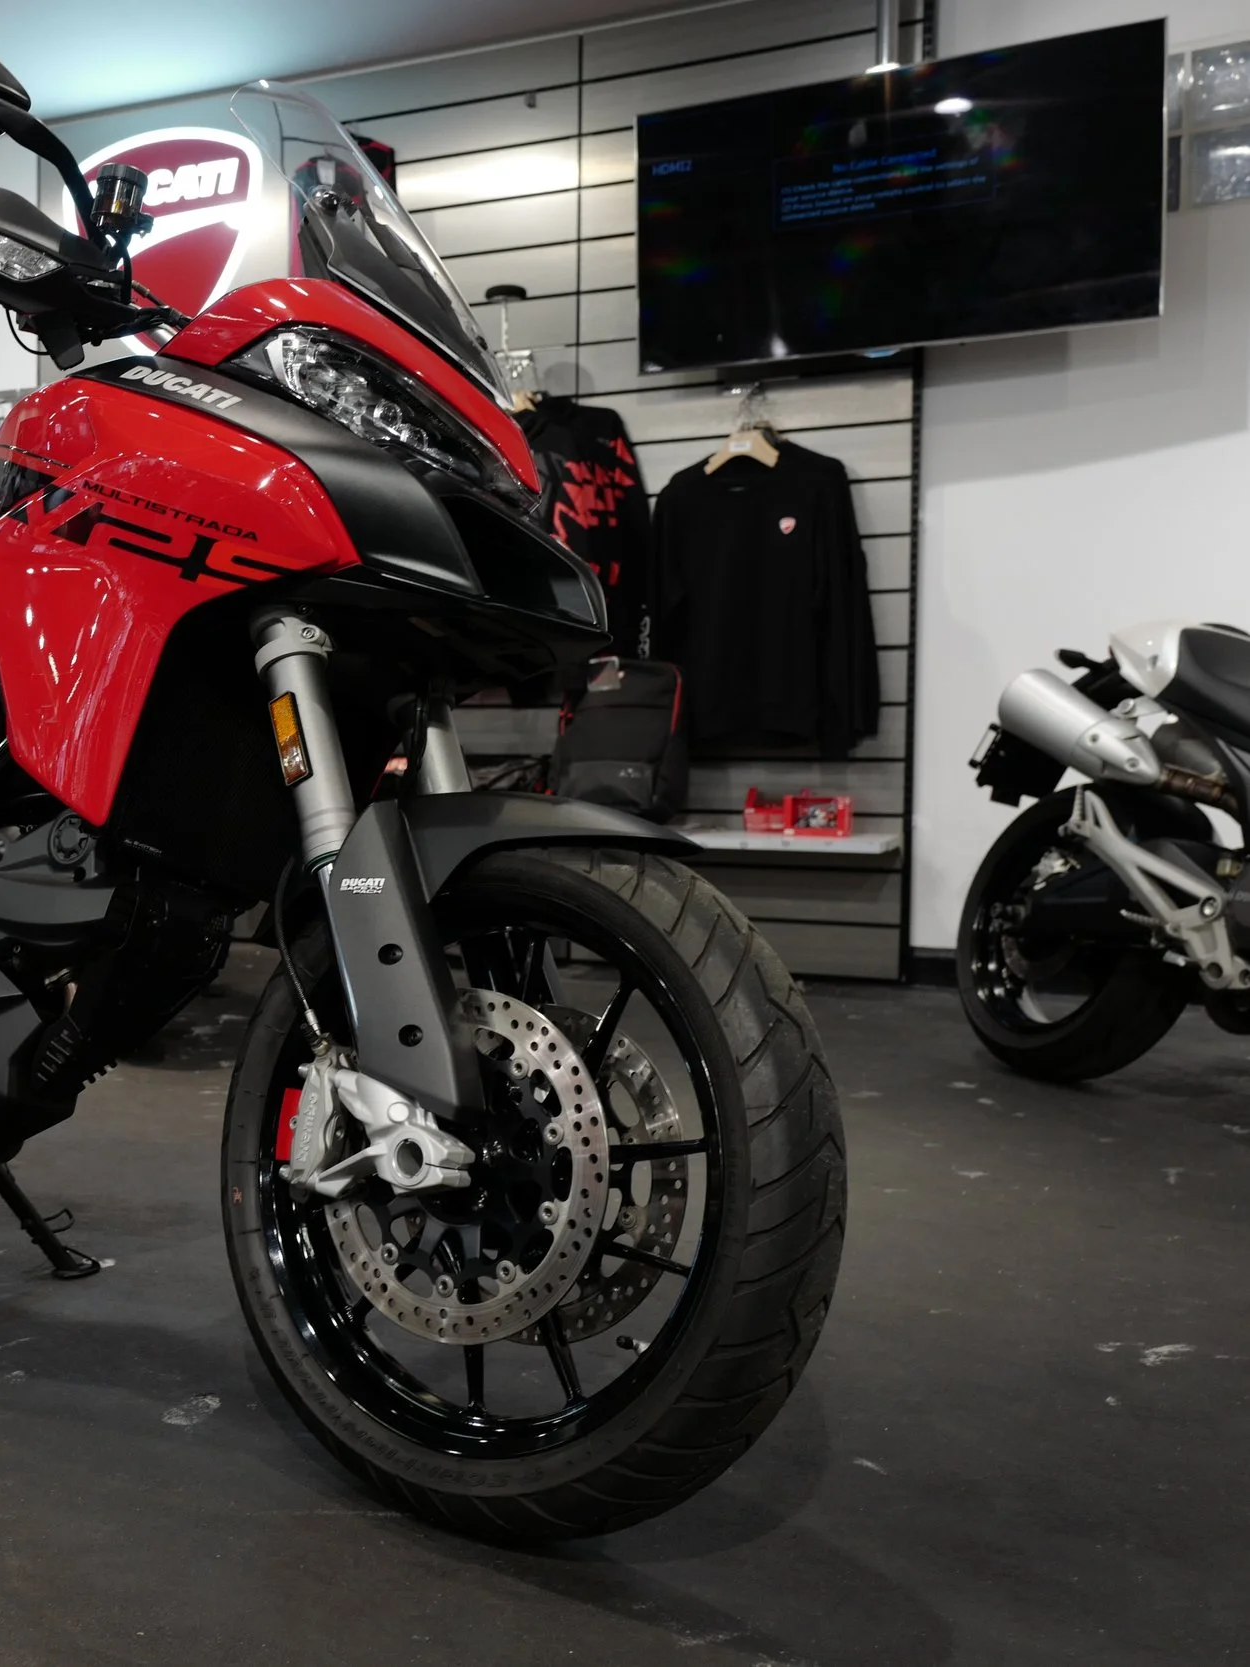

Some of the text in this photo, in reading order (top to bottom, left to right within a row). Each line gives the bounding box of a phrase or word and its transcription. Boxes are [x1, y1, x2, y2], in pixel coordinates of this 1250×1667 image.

[120, 365, 242, 411] DUCATI
[82, 479, 258, 542] MULTISTRADA
[341, 877, 385, 887] DUCATI
[296, 1091, 319, 1163] brembo
